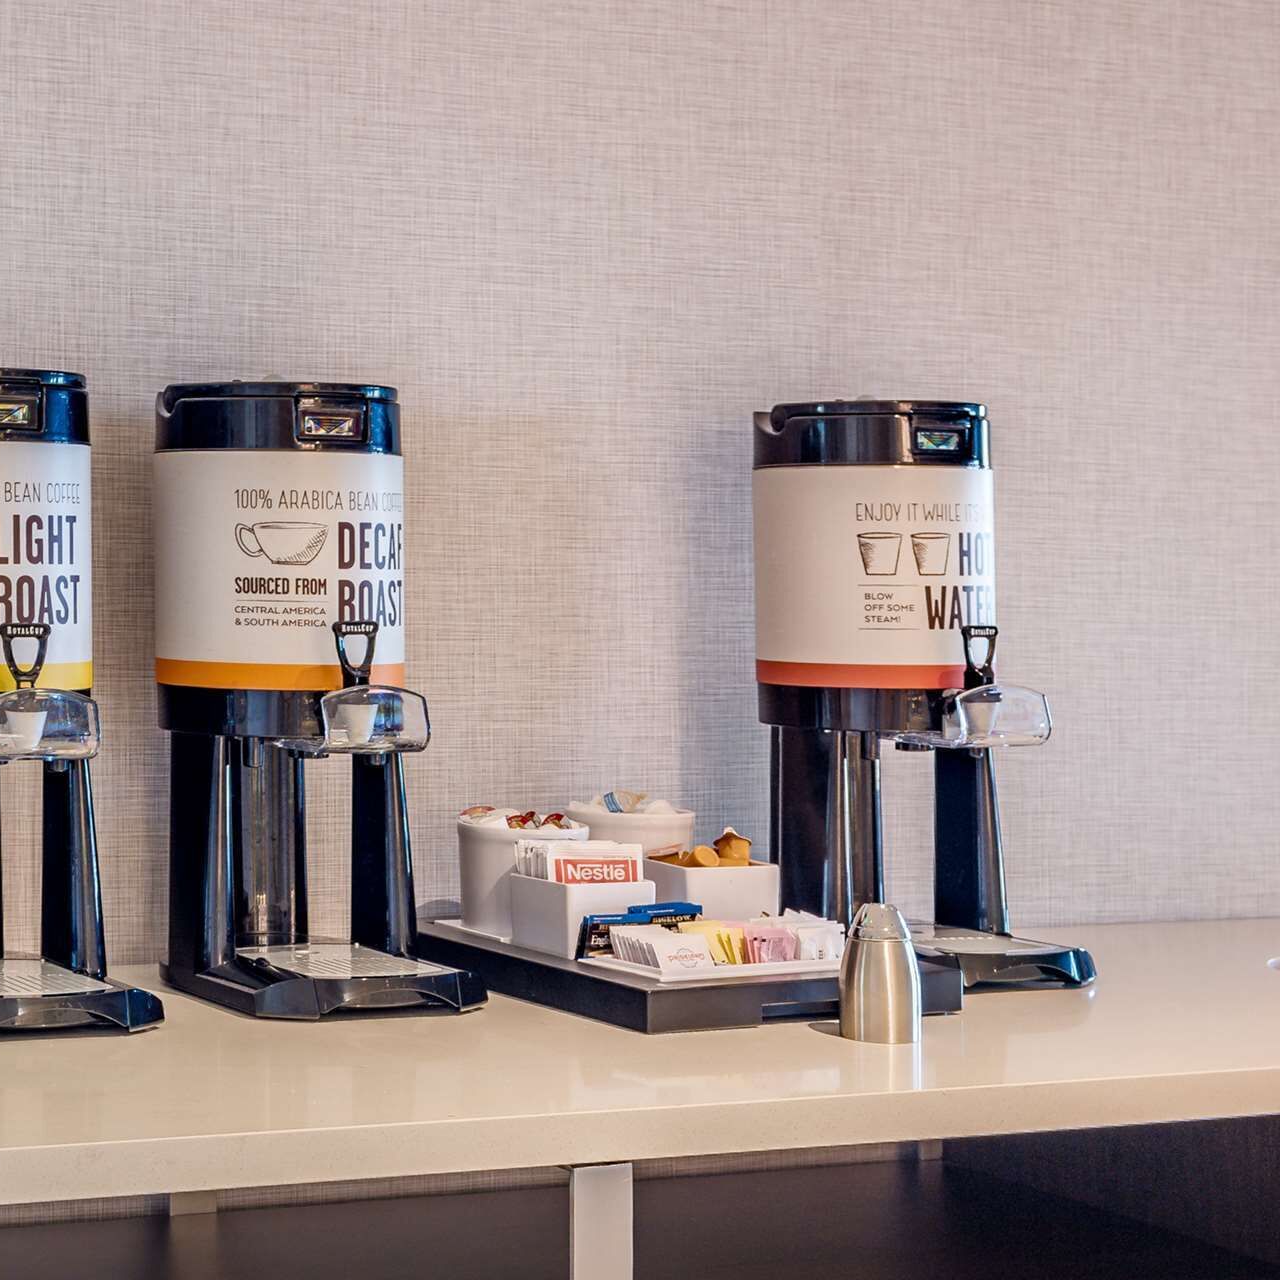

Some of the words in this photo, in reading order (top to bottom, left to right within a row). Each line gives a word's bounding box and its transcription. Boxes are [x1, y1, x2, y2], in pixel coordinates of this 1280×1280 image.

[4, 482, 41, 504] BEAN
[46, 483, 81, 504] COFFEE
[234, 488, 272, 510] 100%
[278, 489, 344, 511] ARABICA
[349, 490, 378, 512] BEAN
[855, 502, 901, 522] ENJOY
[907, 503, 919, 522] IT
[922, 503, 961, 522] WHILE
[234, 576, 290, 595] SOURCED
[295, 577, 328, 596] FROM
[338, 579, 402, 627] ROAST
[864, 592, 894, 601] BLOW
[234, 605, 281, 615] CENTRAL
[282, 606, 327, 616] AMERICA
[864, 604, 885, 612] OFF
[887, 604, 916, 612] SOME
[234, 618, 242, 627] &
[244, 618, 280, 627] SOUTH
[281, 619, 328, 628] AMERICA
[864, 615, 902, 623] STEAM!
